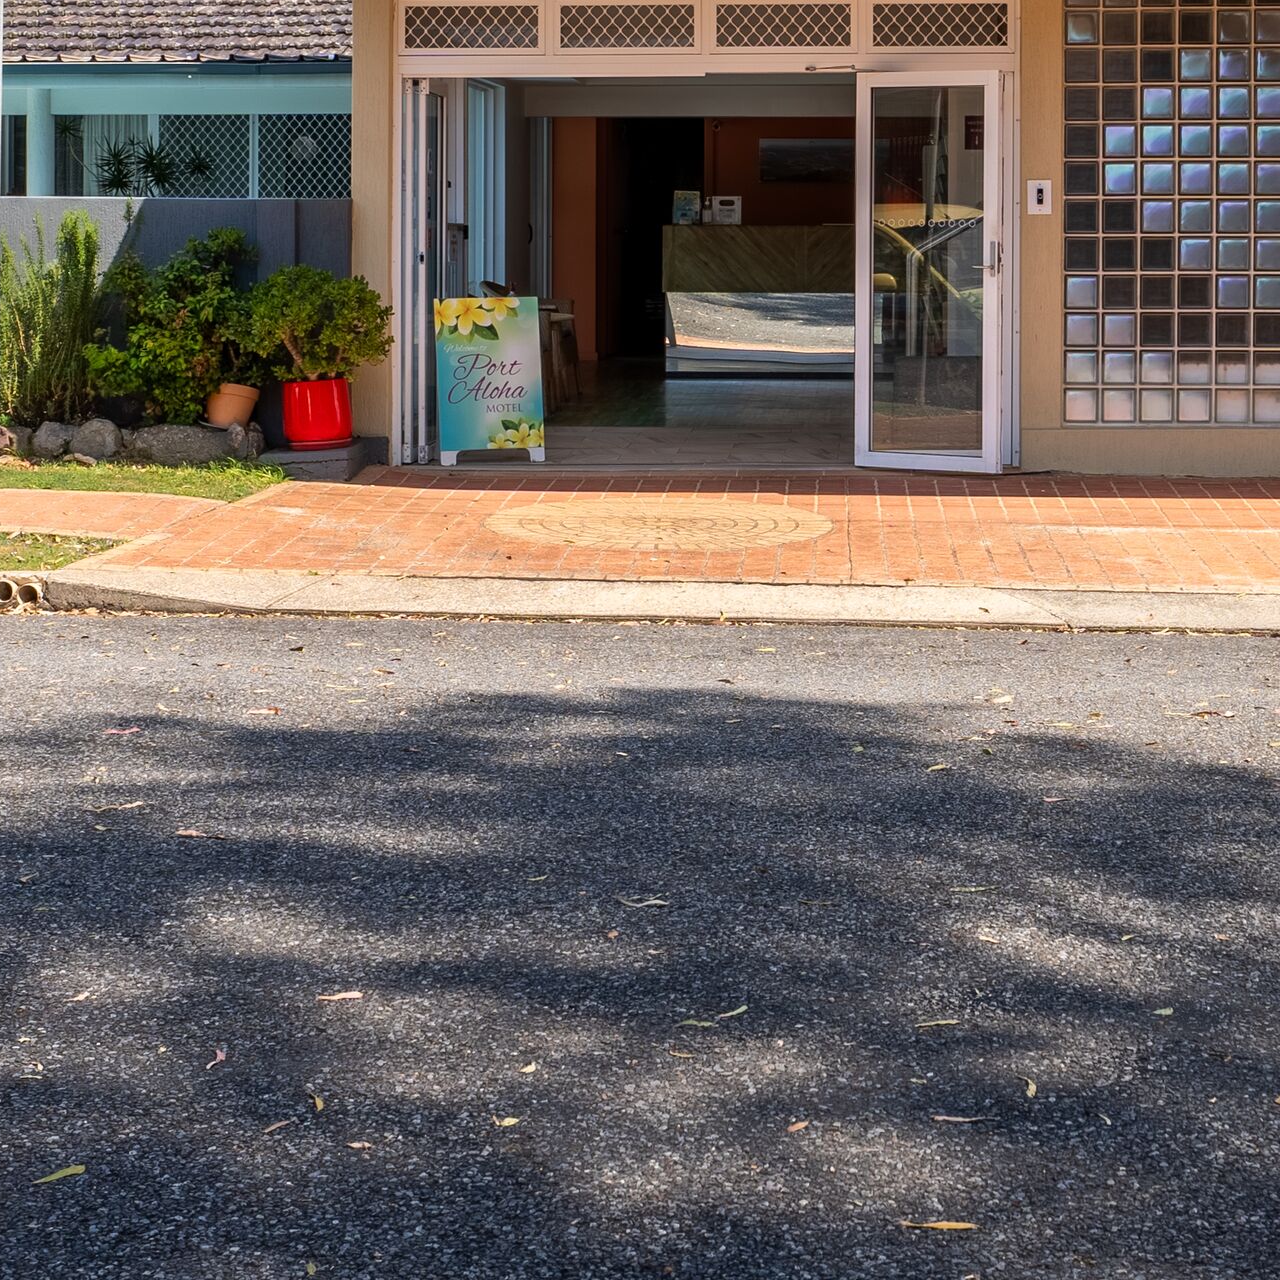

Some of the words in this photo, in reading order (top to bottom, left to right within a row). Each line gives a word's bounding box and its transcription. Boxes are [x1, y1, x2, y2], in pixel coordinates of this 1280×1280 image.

[453, 353, 523, 381] Port
[447, 376, 529, 405] Aloha
[486, 404, 523, 413] MOTEL
